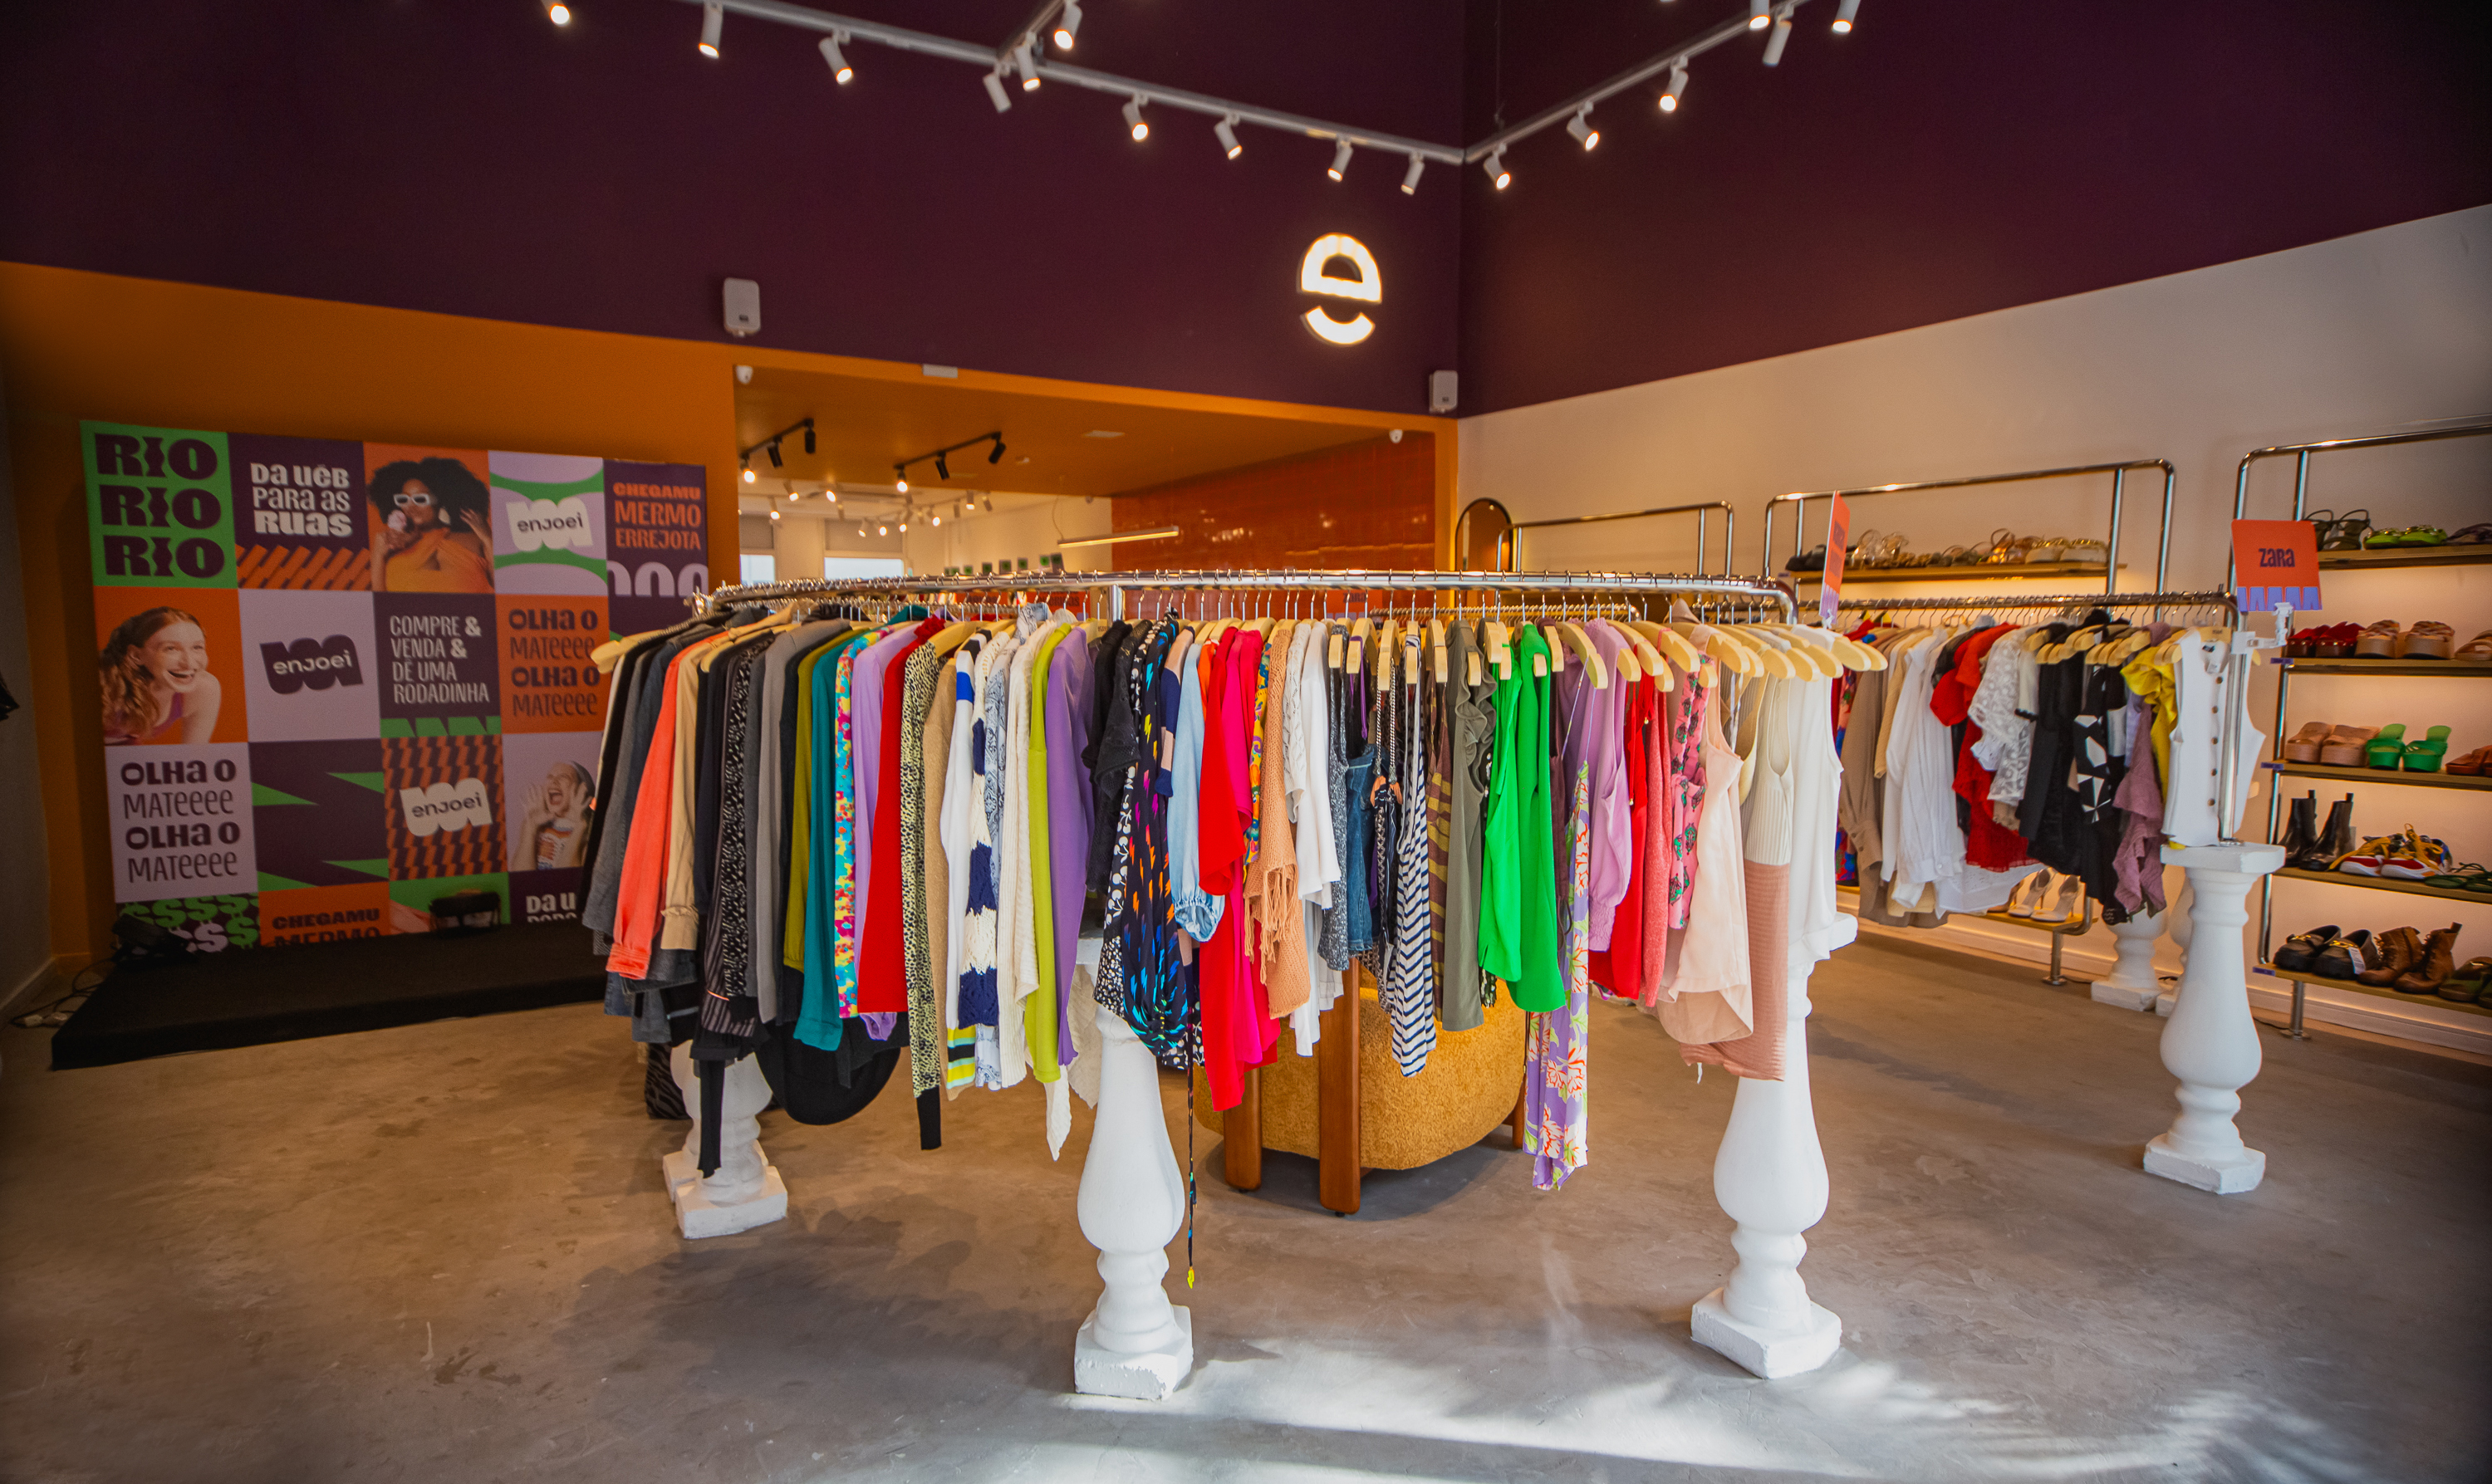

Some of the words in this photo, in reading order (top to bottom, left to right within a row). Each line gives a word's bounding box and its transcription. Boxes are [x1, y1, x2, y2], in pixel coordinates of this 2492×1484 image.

[95, 433, 218, 480] RIO
[613, 482, 701, 500] CHEGAMU
[99, 484, 222, 530] RIO
[614, 500, 701, 527] MERMO
[615, 527, 701, 550] ERREJOTA
[103, 535, 225, 578] RIO
[390, 615, 461, 637] COMPRE
[464, 616, 482, 637] &
[390, 638, 446, 659] VENDA
[450, 638, 468, 659] &
[417, 661, 458, 682] UMA
[393, 683, 490, 704] RODADINHA
[272, 908, 380, 929] CHEGAMU
